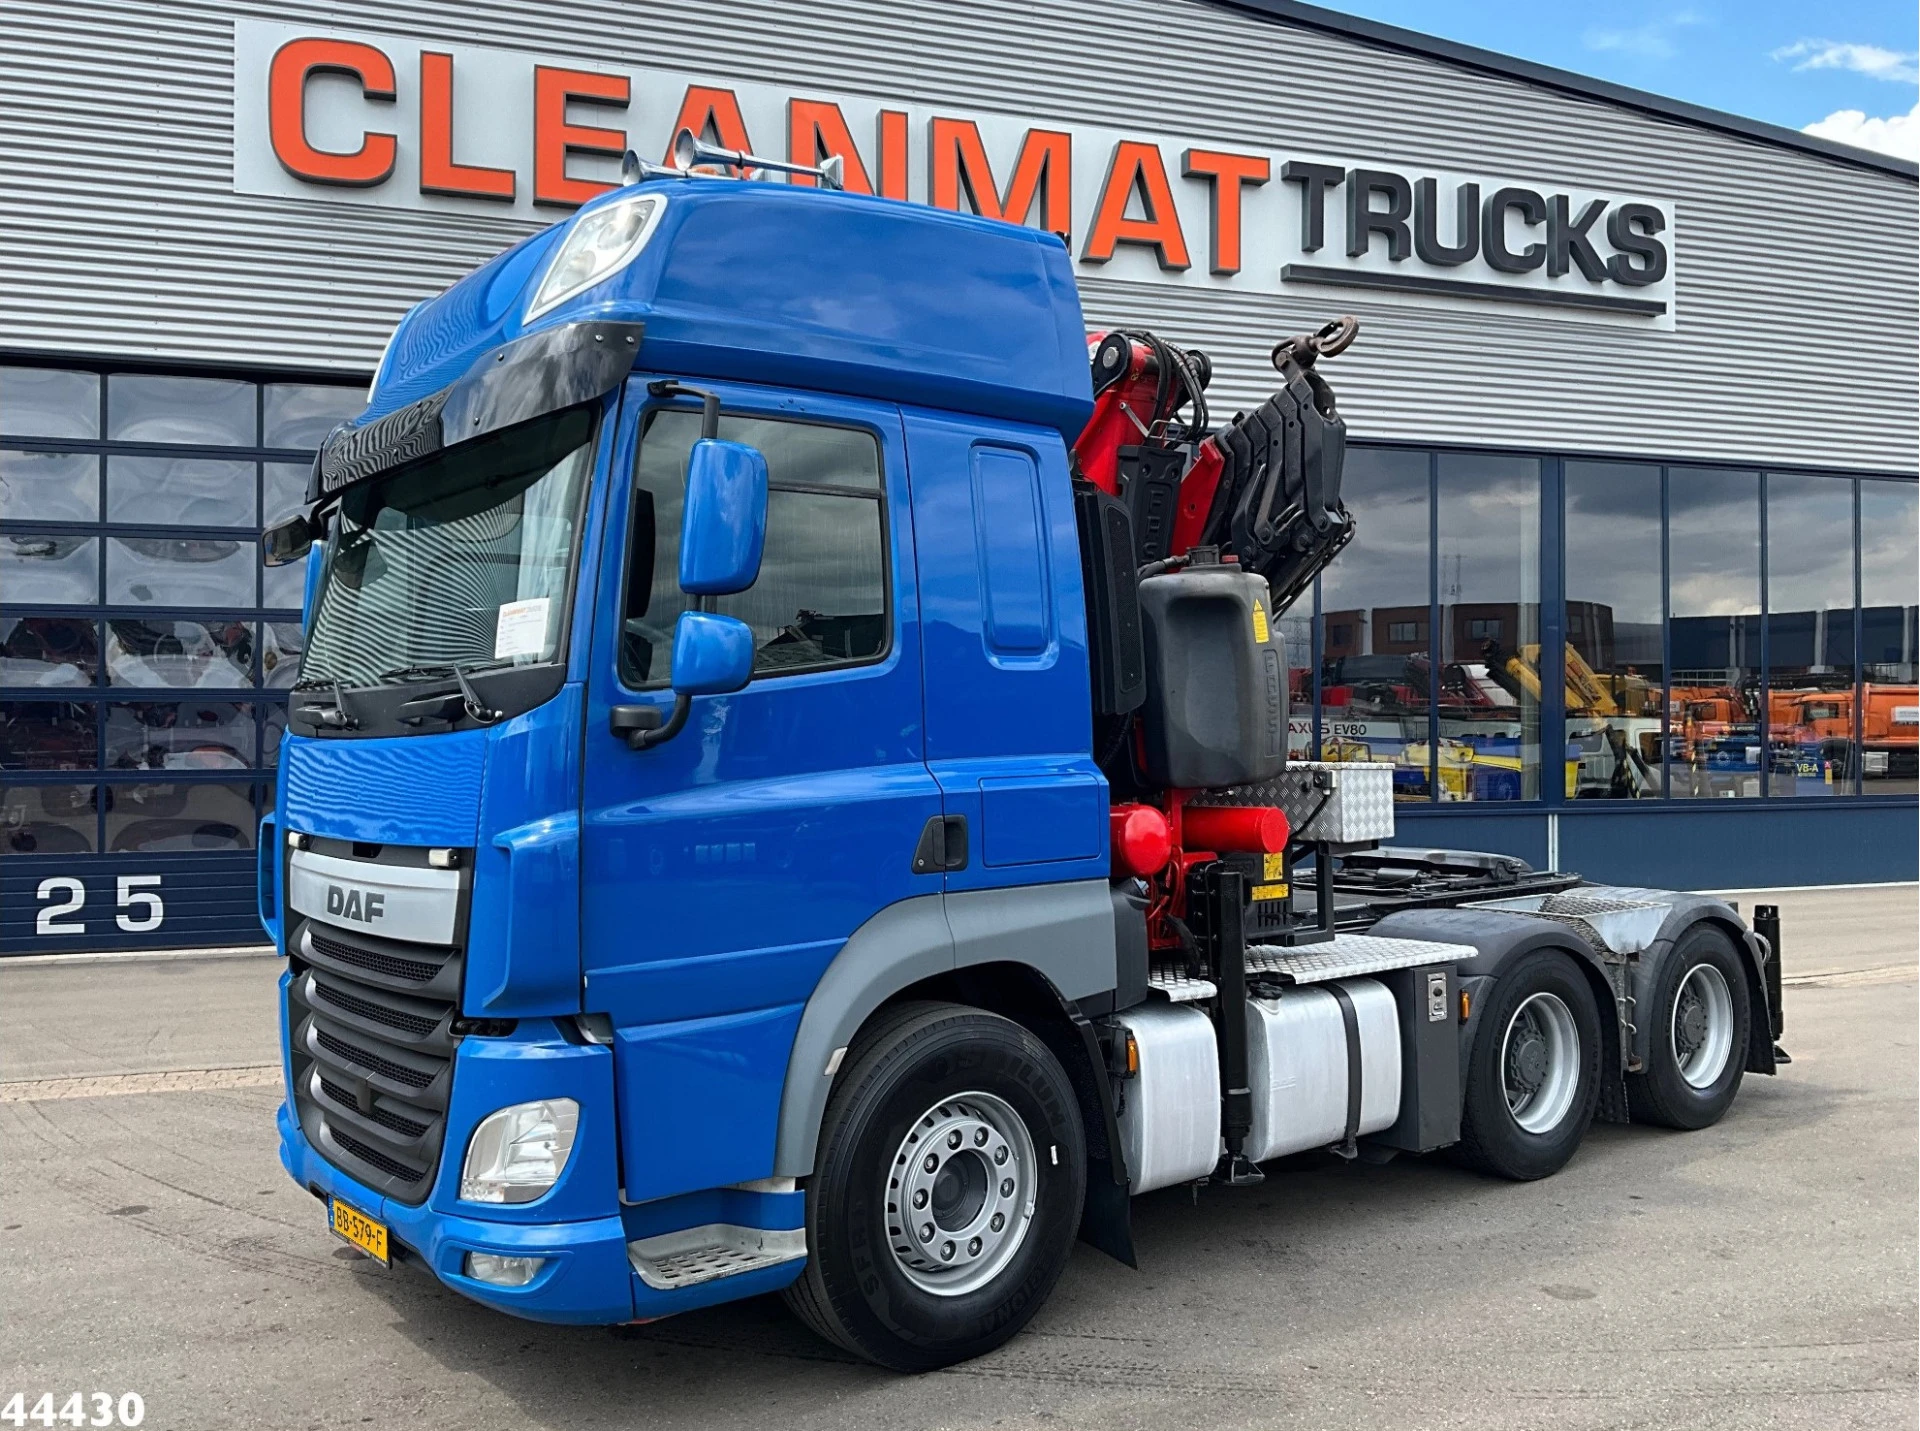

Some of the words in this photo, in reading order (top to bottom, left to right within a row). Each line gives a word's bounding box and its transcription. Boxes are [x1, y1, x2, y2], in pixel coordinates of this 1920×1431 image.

[268, 37, 1270, 276] CLEANMAT
[1281, 160, 1668, 287] TRUCKS
[1334, 723, 1367, 736] EV80
[326, 884, 385, 924] DAF
[336, 1205, 383, 1252] BB-579-F
